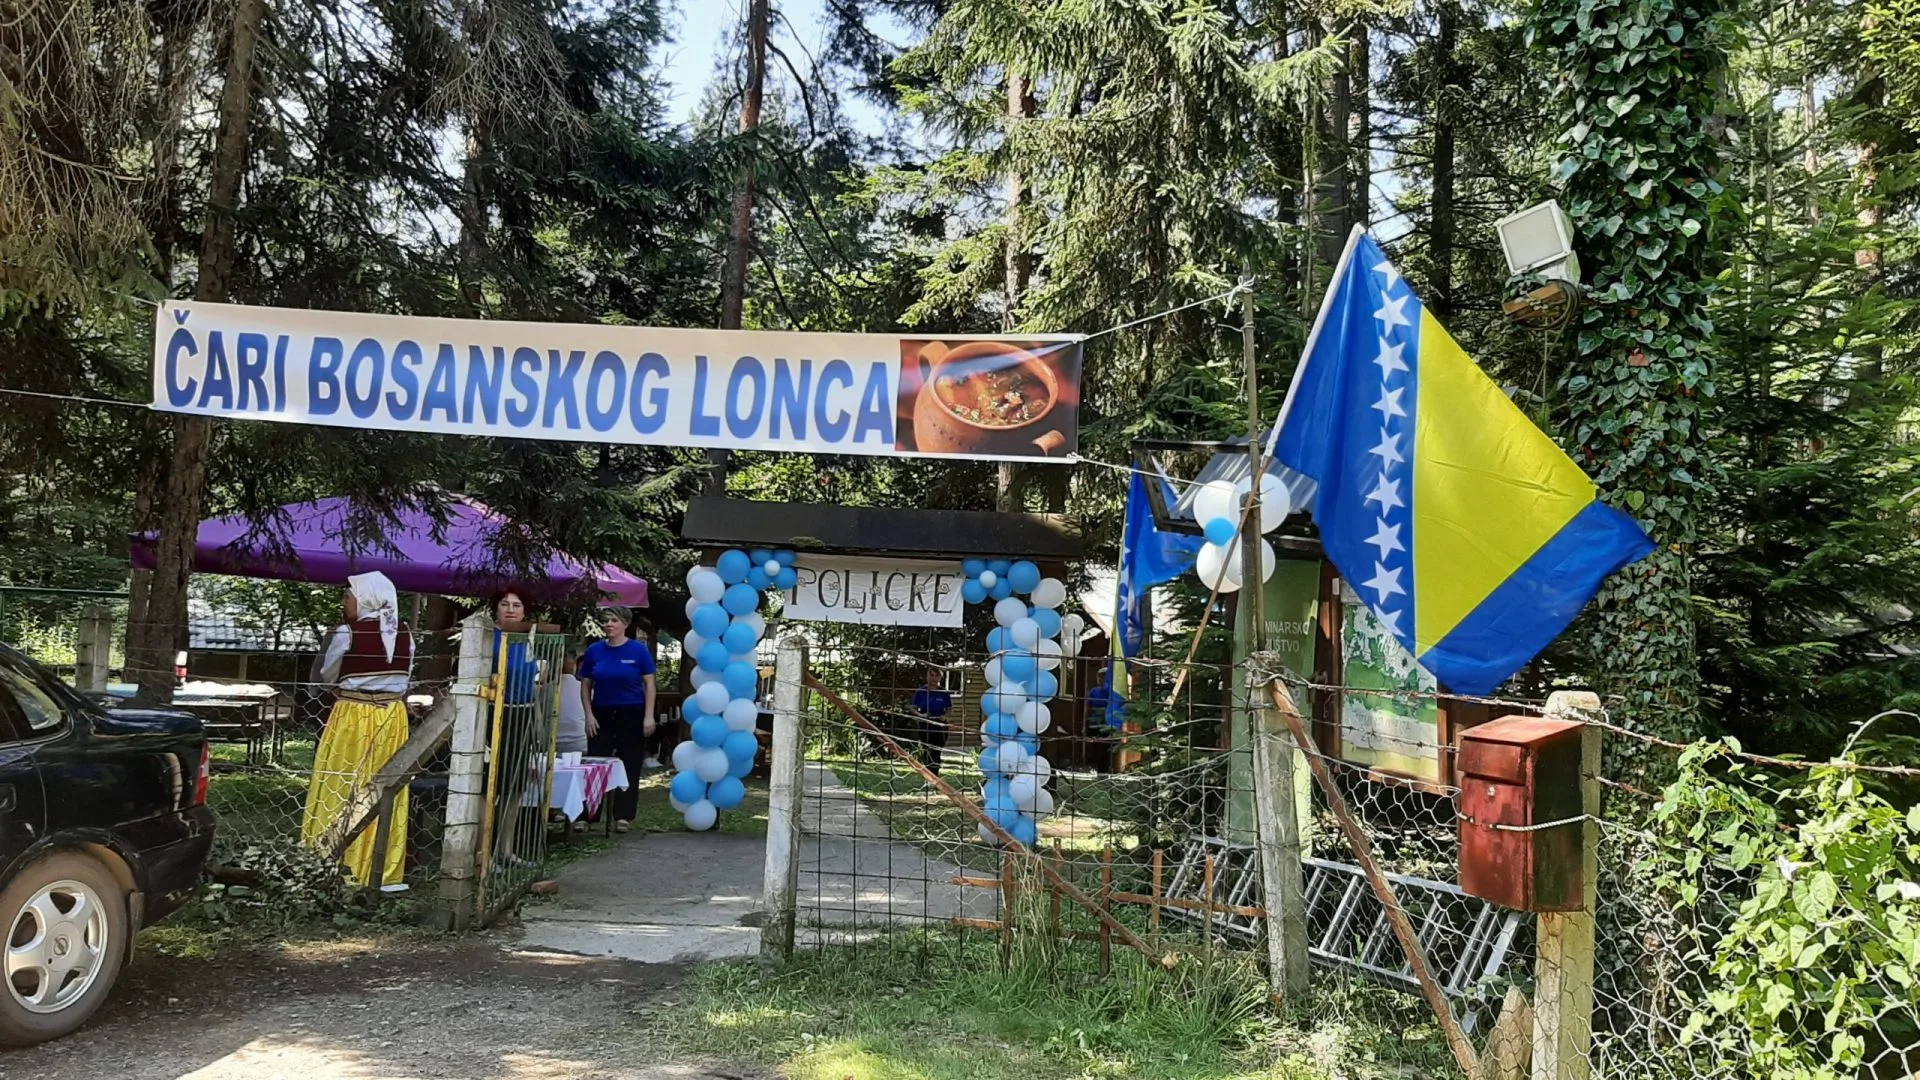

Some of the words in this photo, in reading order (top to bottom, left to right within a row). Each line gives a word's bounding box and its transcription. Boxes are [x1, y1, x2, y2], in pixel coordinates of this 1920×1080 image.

[165, 309, 289, 413] ČARI
[308, 336, 671, 435] BOSANSKOG
[689, 355, 894, 445] LONCA
[1264, 620, 1309, 635] NINARSKO
